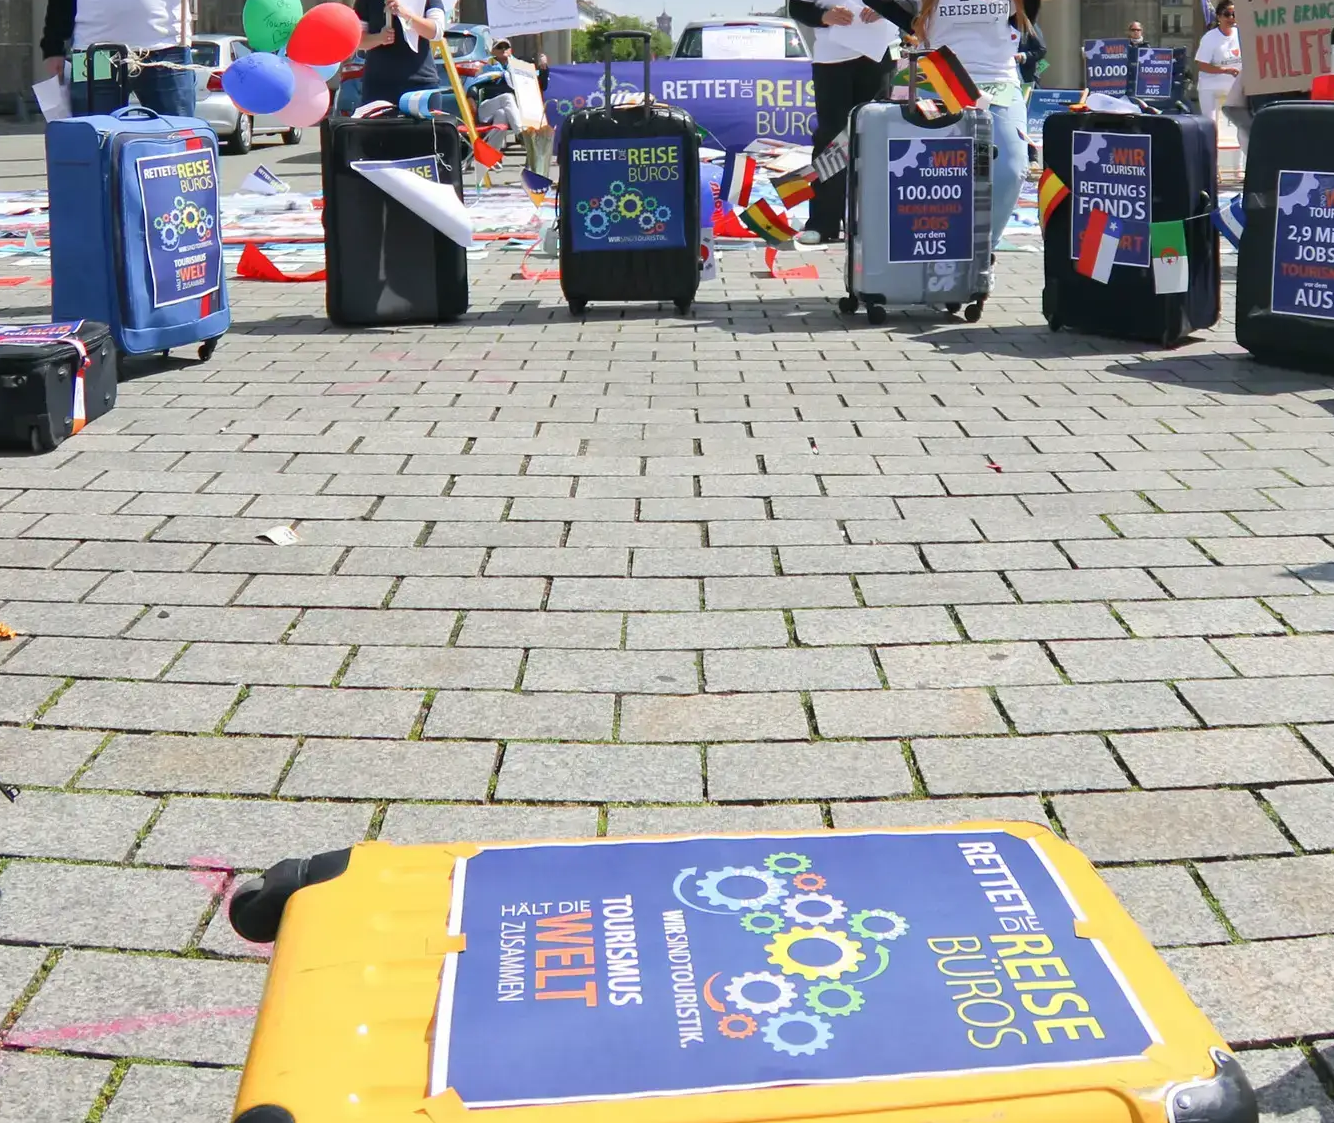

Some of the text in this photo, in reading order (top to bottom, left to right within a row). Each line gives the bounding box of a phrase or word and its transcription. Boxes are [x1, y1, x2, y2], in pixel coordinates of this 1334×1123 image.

[1254, 8, 1287, 29] WIR
[1255, 27, 1332, 81] HILFE
[1087, 64, 1128, 78] 10.000
[1140, 66, 1168, 75] 100.000
[661, 78, 816, 107] RETTET DIE REIS
[1145, 87, 1160, 96] AUS
[572, 148, 618, 162] RETTET
[627, 146, 680, 165] REISE
[931, 150, 967, 167] WIR
[1113, 147, 1146, 166] WIR
[143, 159, 211, 180] RETTET REISE
[627, 163, 680, 182] BÜROS
[919, 167, 968, 178] TOURISTIK
[1100, 163, 1147, 177] TOURISTIK
[180, 175, 214, 193] BÜROS
[896, 184, 962, 201] 100.000
[911, 216, 950, 231] JOBS
[913, 230, 947, 239] vor dem
[1287, 225, 1313, 244] 2,9
[913, 239, 947, 256] AUS
[173, 253, 207, 268] TOURISMUS
[180, 262, 207, 282] WELT
[1294, 288, 1334, 310] AUS
[500, 899, 592, 918] HÄLT DIE
[601, 893, 644, 1008] TOURISMUS
[957, 840, 1108, 1045] RETTET DIE REISE
[497, 920, 527, 1004] ZUSAMMEN
[534, 910, 599, 1008] WELT
[927, 935, 1029, 1050] BÜROS
